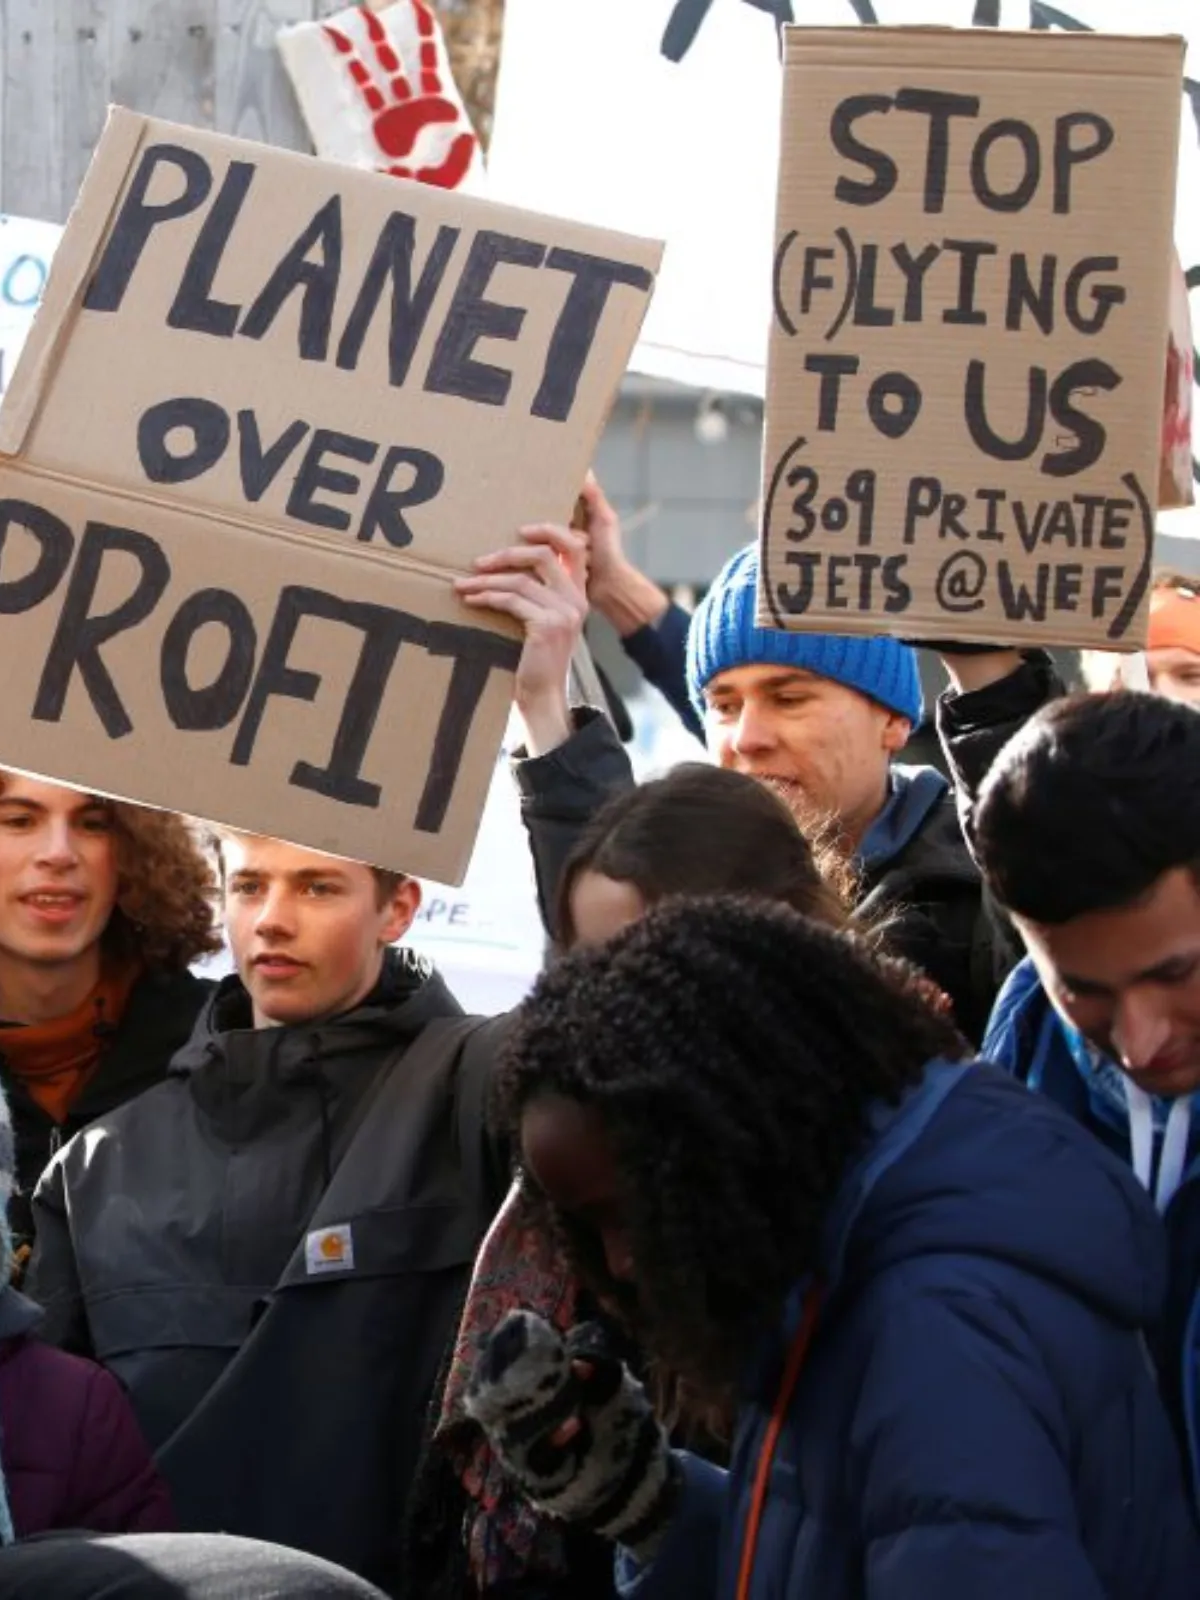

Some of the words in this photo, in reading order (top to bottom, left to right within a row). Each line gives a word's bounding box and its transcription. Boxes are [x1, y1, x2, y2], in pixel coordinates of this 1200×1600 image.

[830, 87, 1114, 214] STOP
[82, 142, 655, 424] PLANET
[772, 227, 1125, 340] (F)LYING
[136, 397, 445, 548] OVER
[804, 354, 922, 439] TO
[964, 358, 1122, 477] US
[904, 475, 1134, 553] PRIVATE
[777, 552, 911, 613] JETS
